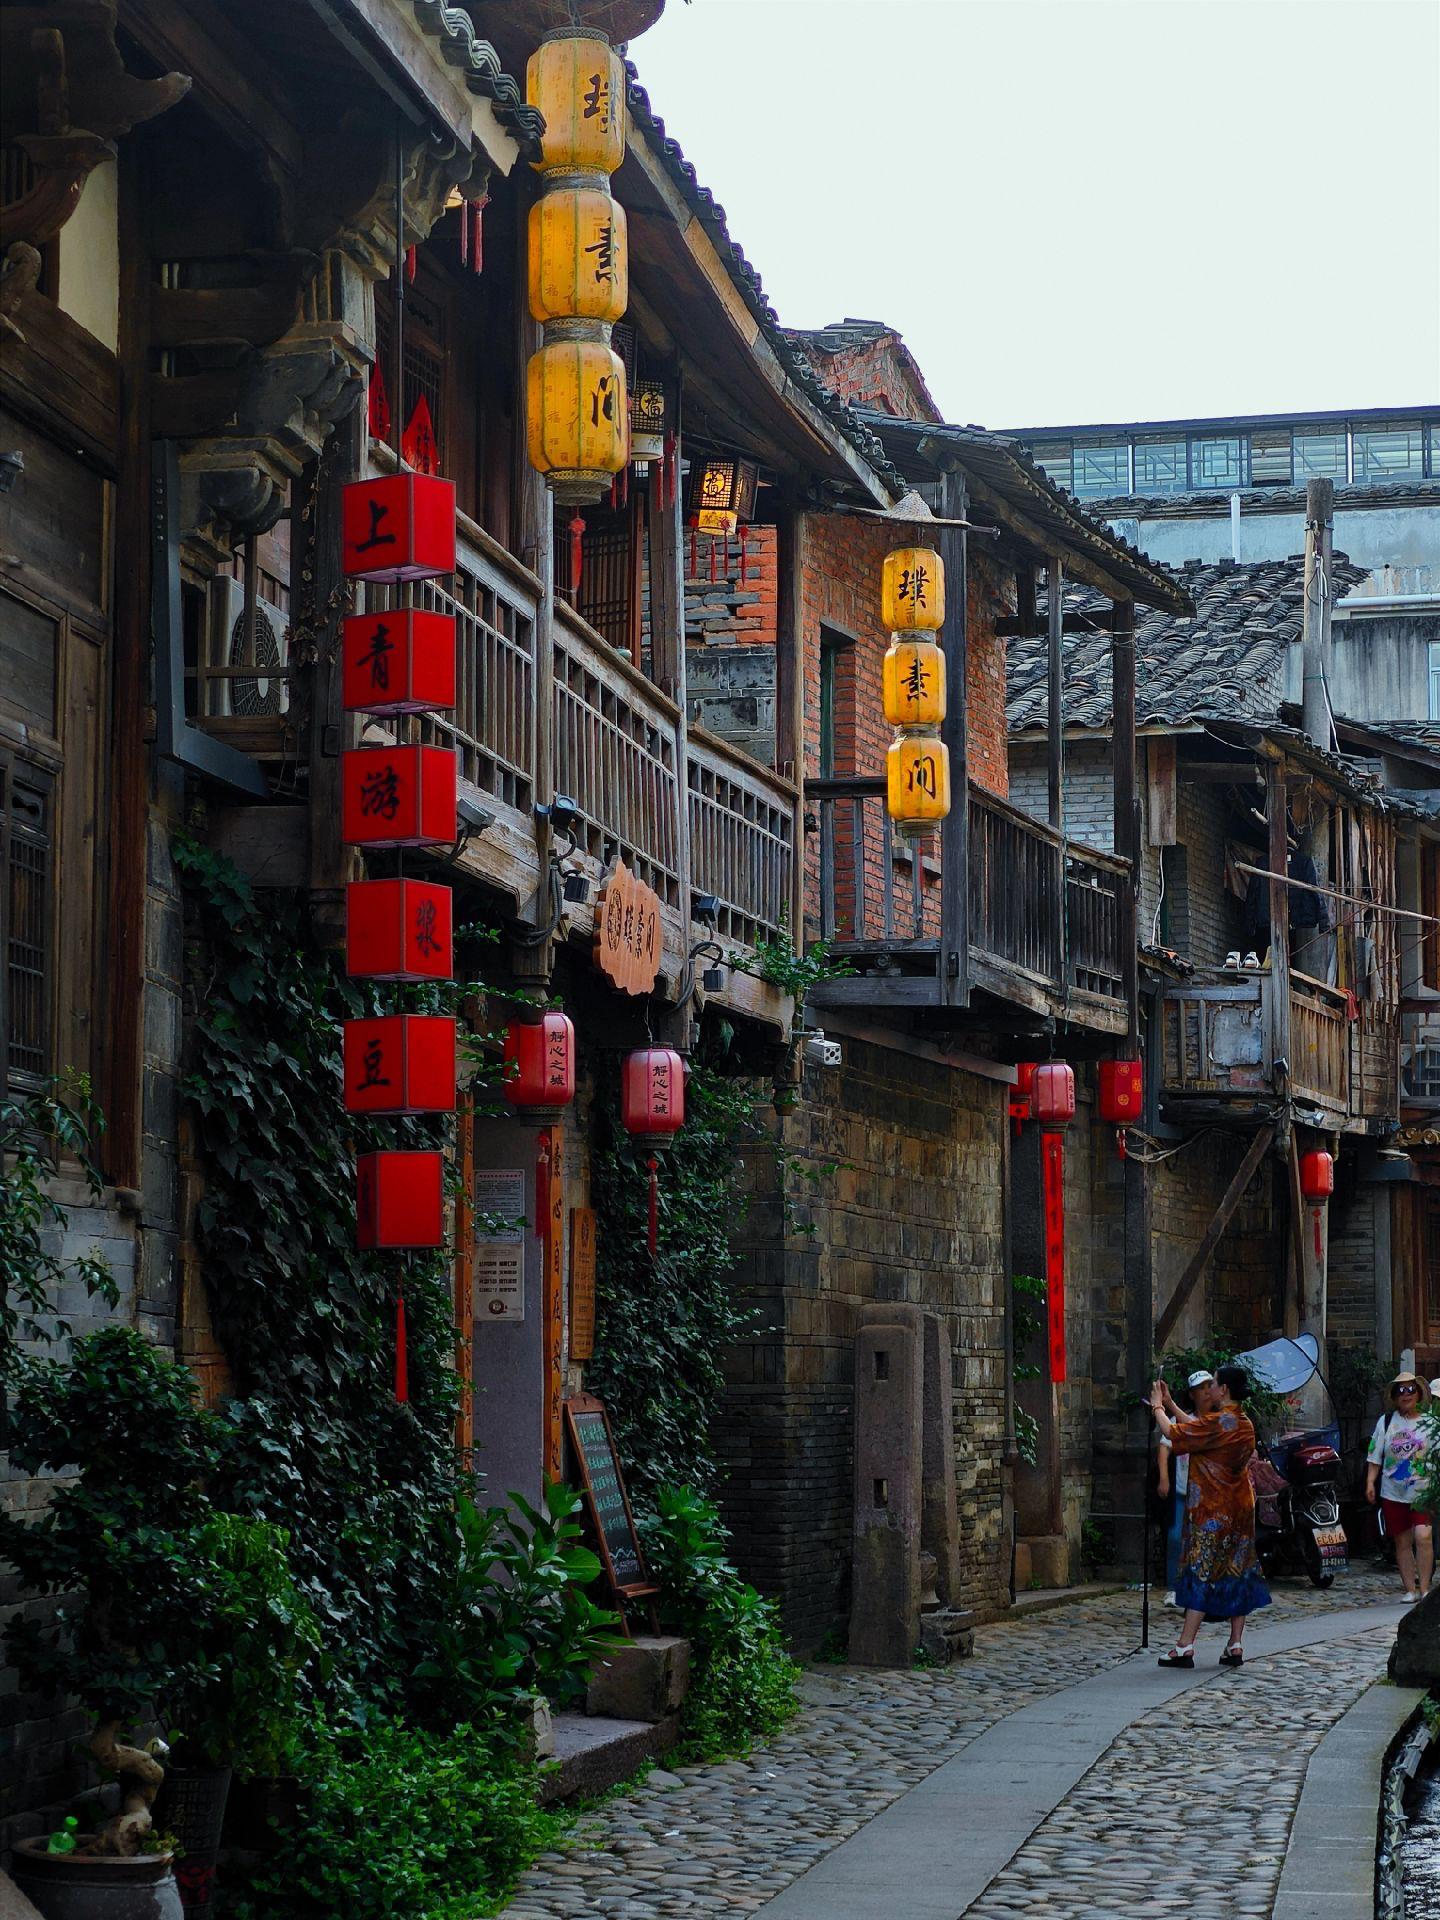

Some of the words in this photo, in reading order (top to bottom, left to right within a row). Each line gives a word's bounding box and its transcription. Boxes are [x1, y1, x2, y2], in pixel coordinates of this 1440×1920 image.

[584, 217, 620, 284] 素
[642, 392, 664, 416] 福
[704, 470, 725, 495] 福
[355, 499, 396, 552] 上
[898, 565, 930, 609] 璞
[355, 623, 395, 691] 青
[900, 658, 930, 702] 素
[360, 765, 401, 821] 游
[356, 1039, 392, 1092] 豆
